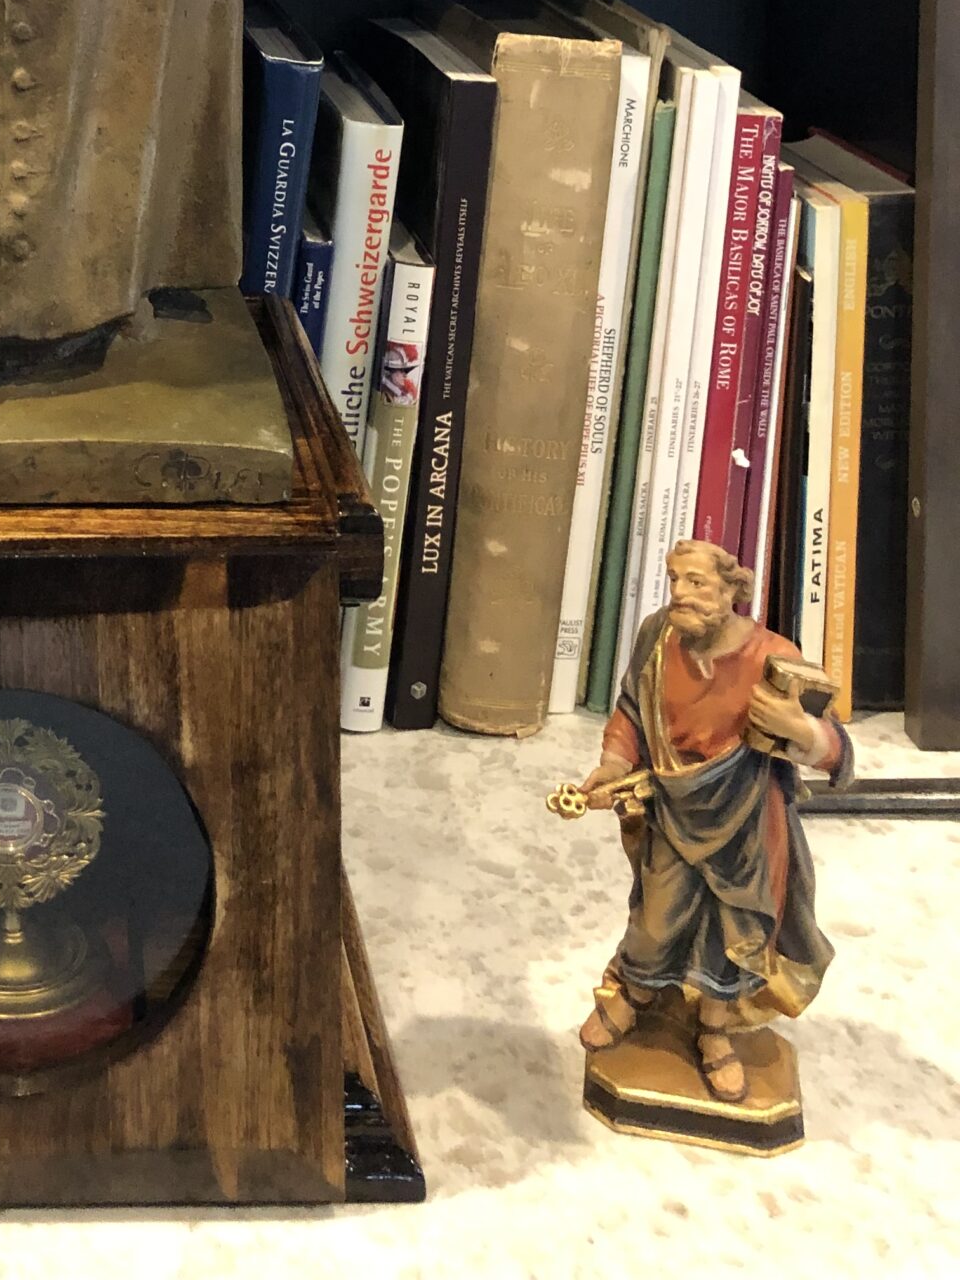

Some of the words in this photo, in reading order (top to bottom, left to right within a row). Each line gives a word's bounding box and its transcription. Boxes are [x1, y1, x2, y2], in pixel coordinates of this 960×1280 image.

[282, 119, 294, 137] LA
[618, 98, 637, 168] MARCHIONE
[740, 124, 759, 159] THE
[272, 141, 296, 215] GUARDIA
[733, 167, 755, 221] MAJOR
[460, 198, 469, 230] ITSELF
[346, 149, 392, 355] Schweizergarde
[455, 231, 466, 266] REVEALS
[724, 228, 749, 311] BASILICAS
[451, 268, 462, 317] ARCHIVES
[843, 238, 857, 311] ENGLISH
[402, 282, 420, 335] ROYAL
[721, 315, 737, 337] OF
[448, 318, 457, 346] SECRET
[444, 347, 455, 382] VATICAN
[598, 328, 616, 394] SHEPHERD
[716, 342, 737, 390] ROME
[442, 383, 451, 399] THE
[596, 396, 608, 412] OF
[840, 371, 853, 437] EDITION
[429, 411, 453, 499] ARCANA
[591, 415, 607, 454] SOULS
[837, 446, 850, 484] NEW
[428, 505, 443, 531] IN
[422, 534, 441, 574] LUX
[811, 508, 824, 604] FATIMA
